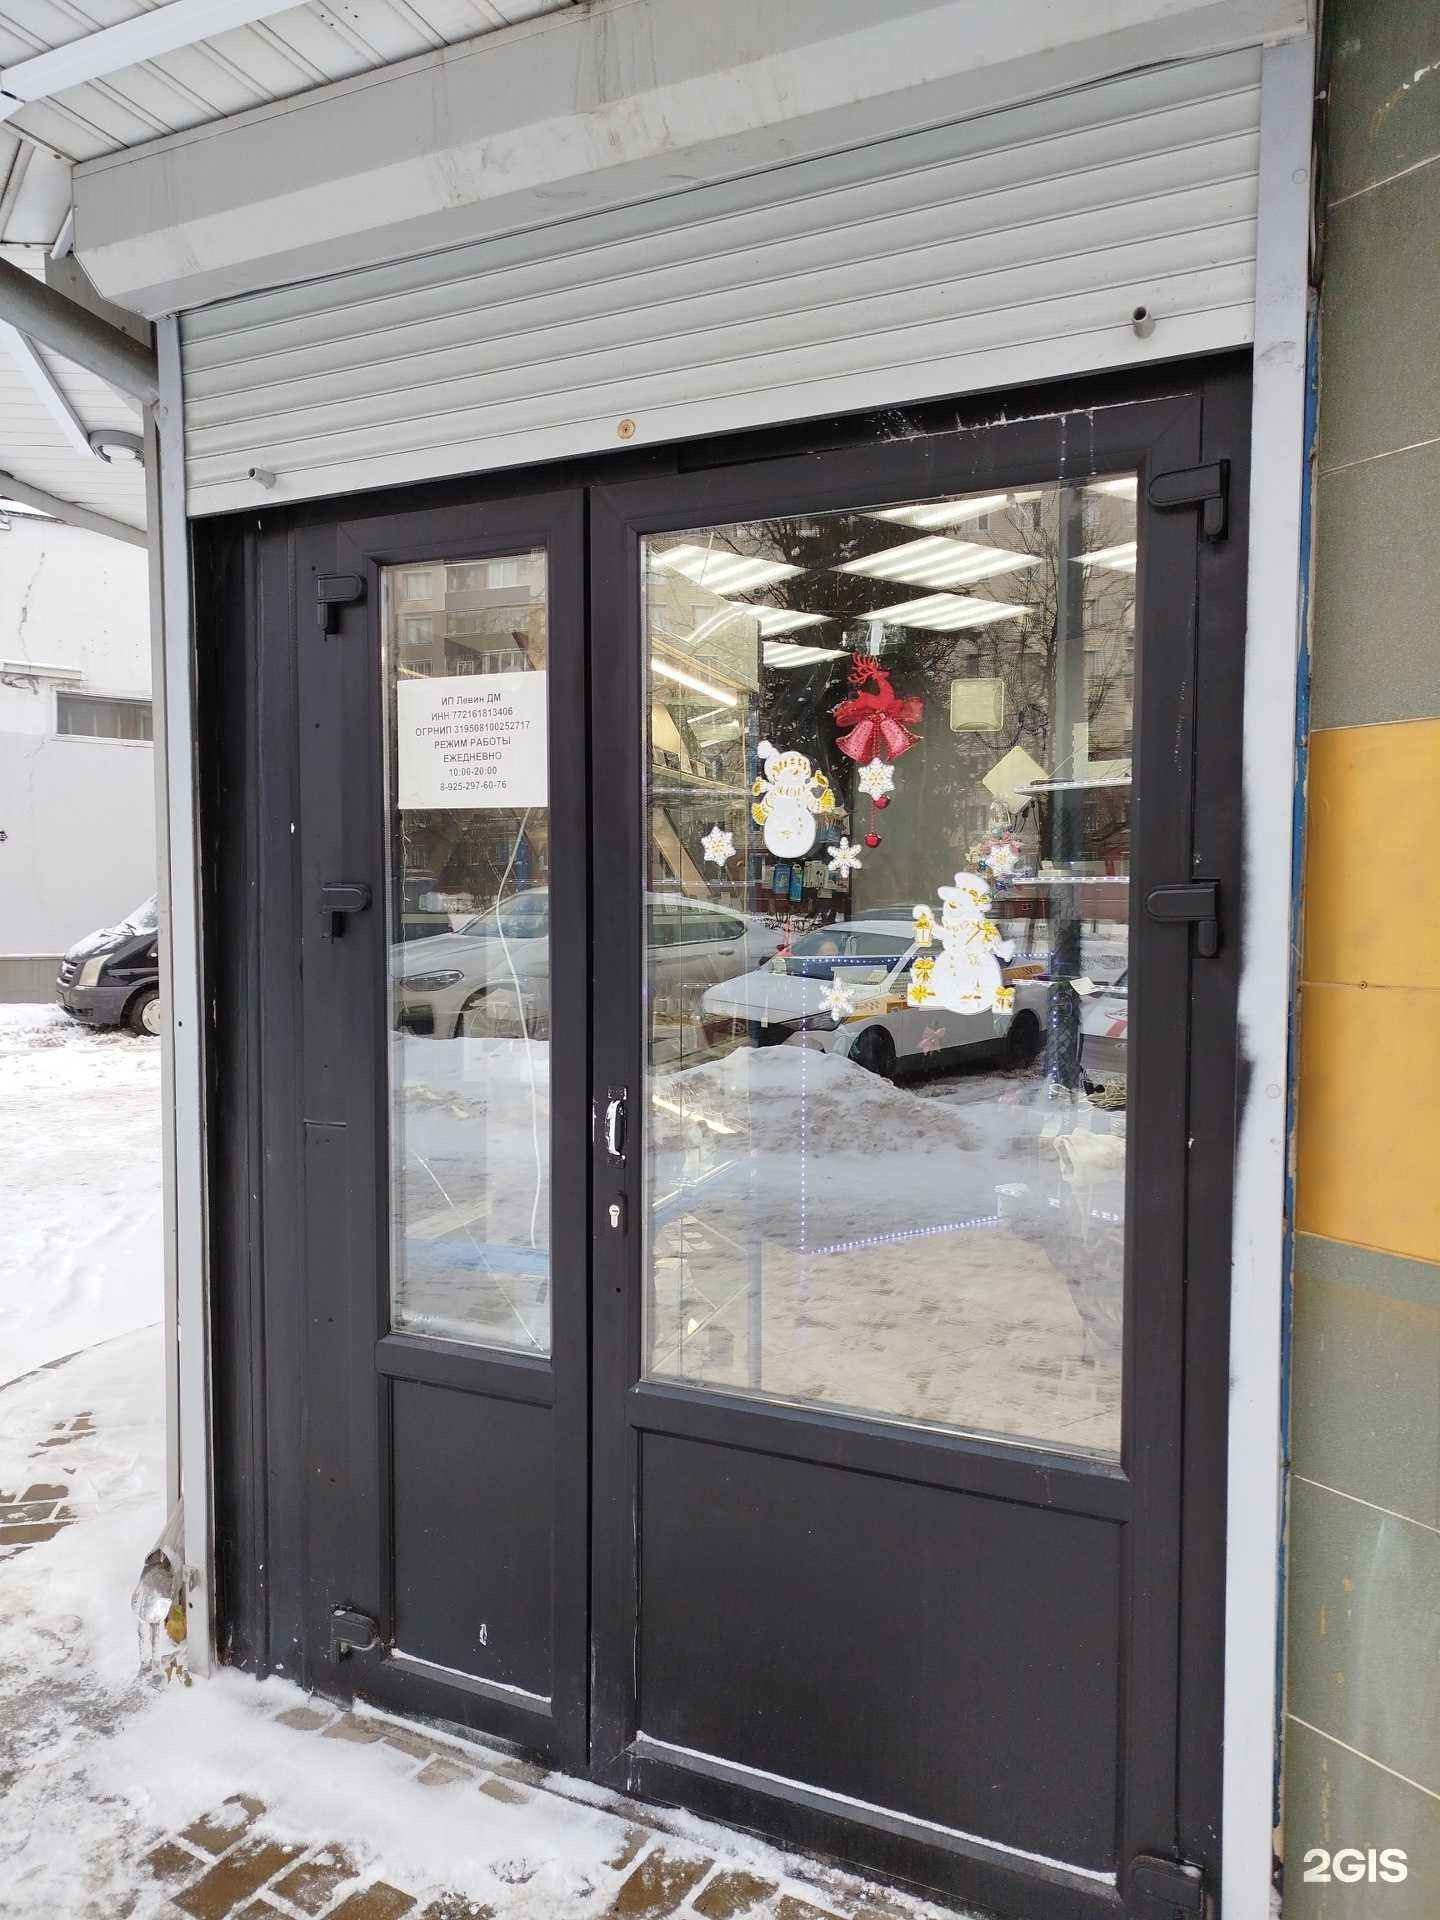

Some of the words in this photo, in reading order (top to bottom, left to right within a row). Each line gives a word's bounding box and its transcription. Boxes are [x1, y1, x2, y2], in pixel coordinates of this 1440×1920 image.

[442, 697, 454, 706] ИП
[487, 693, 501, 704] ДМ
[432, 712, 450, 721] ИНН
[453, 707, 513, 719] 772161813406
[415, 726, 452, 736] ОГРНИП
[434, 739, 468, 749] РЕЖИМ
[470, 736, 511, 747] РАБОТЫ
[443, 752, 502, 763] ЕЖЕДНЕВНО
[449, 766, 497, 777] 10:00-20:00
[440, 780, 507, 791] 8-925-297-60-76
